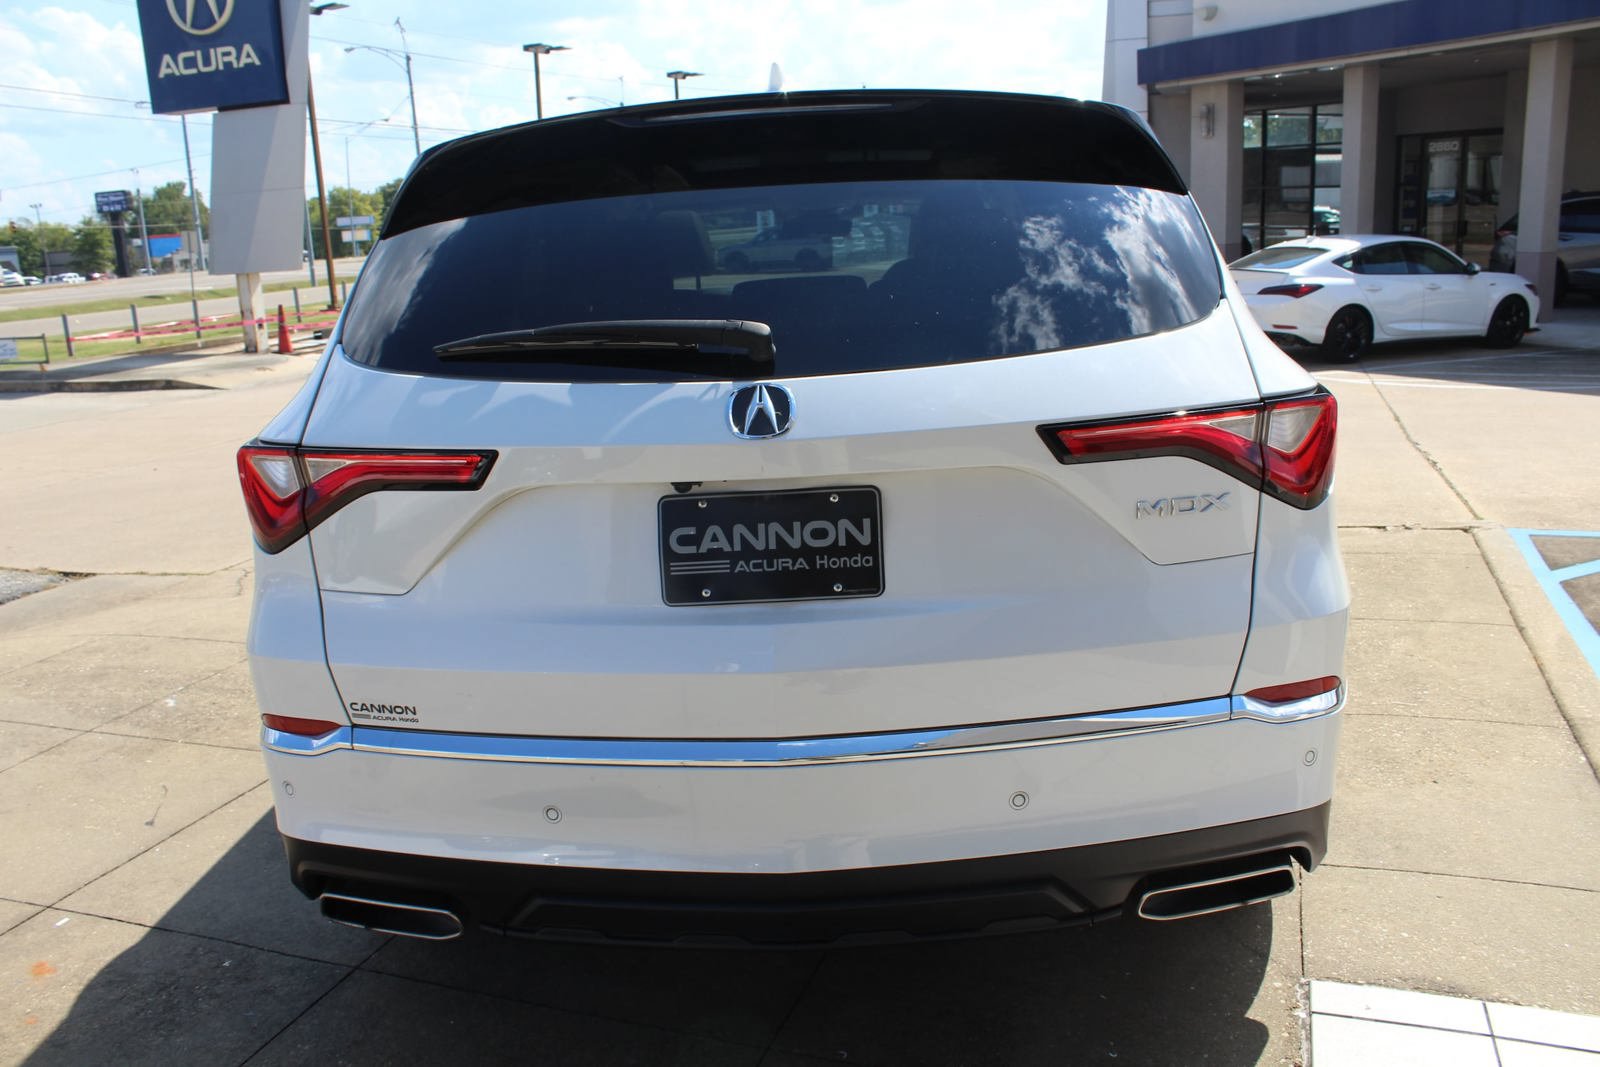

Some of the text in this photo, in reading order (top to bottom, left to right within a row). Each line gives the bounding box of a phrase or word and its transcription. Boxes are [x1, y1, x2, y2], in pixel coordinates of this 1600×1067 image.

[157, 43, 262, 79] ACURA
[1136, 491, 1231, 519] MDX
[669, 518, 871, 554] CANNON
[734, 553, 873, 573] ACURA Honda
[349, 702, 417, 715] CANNON
